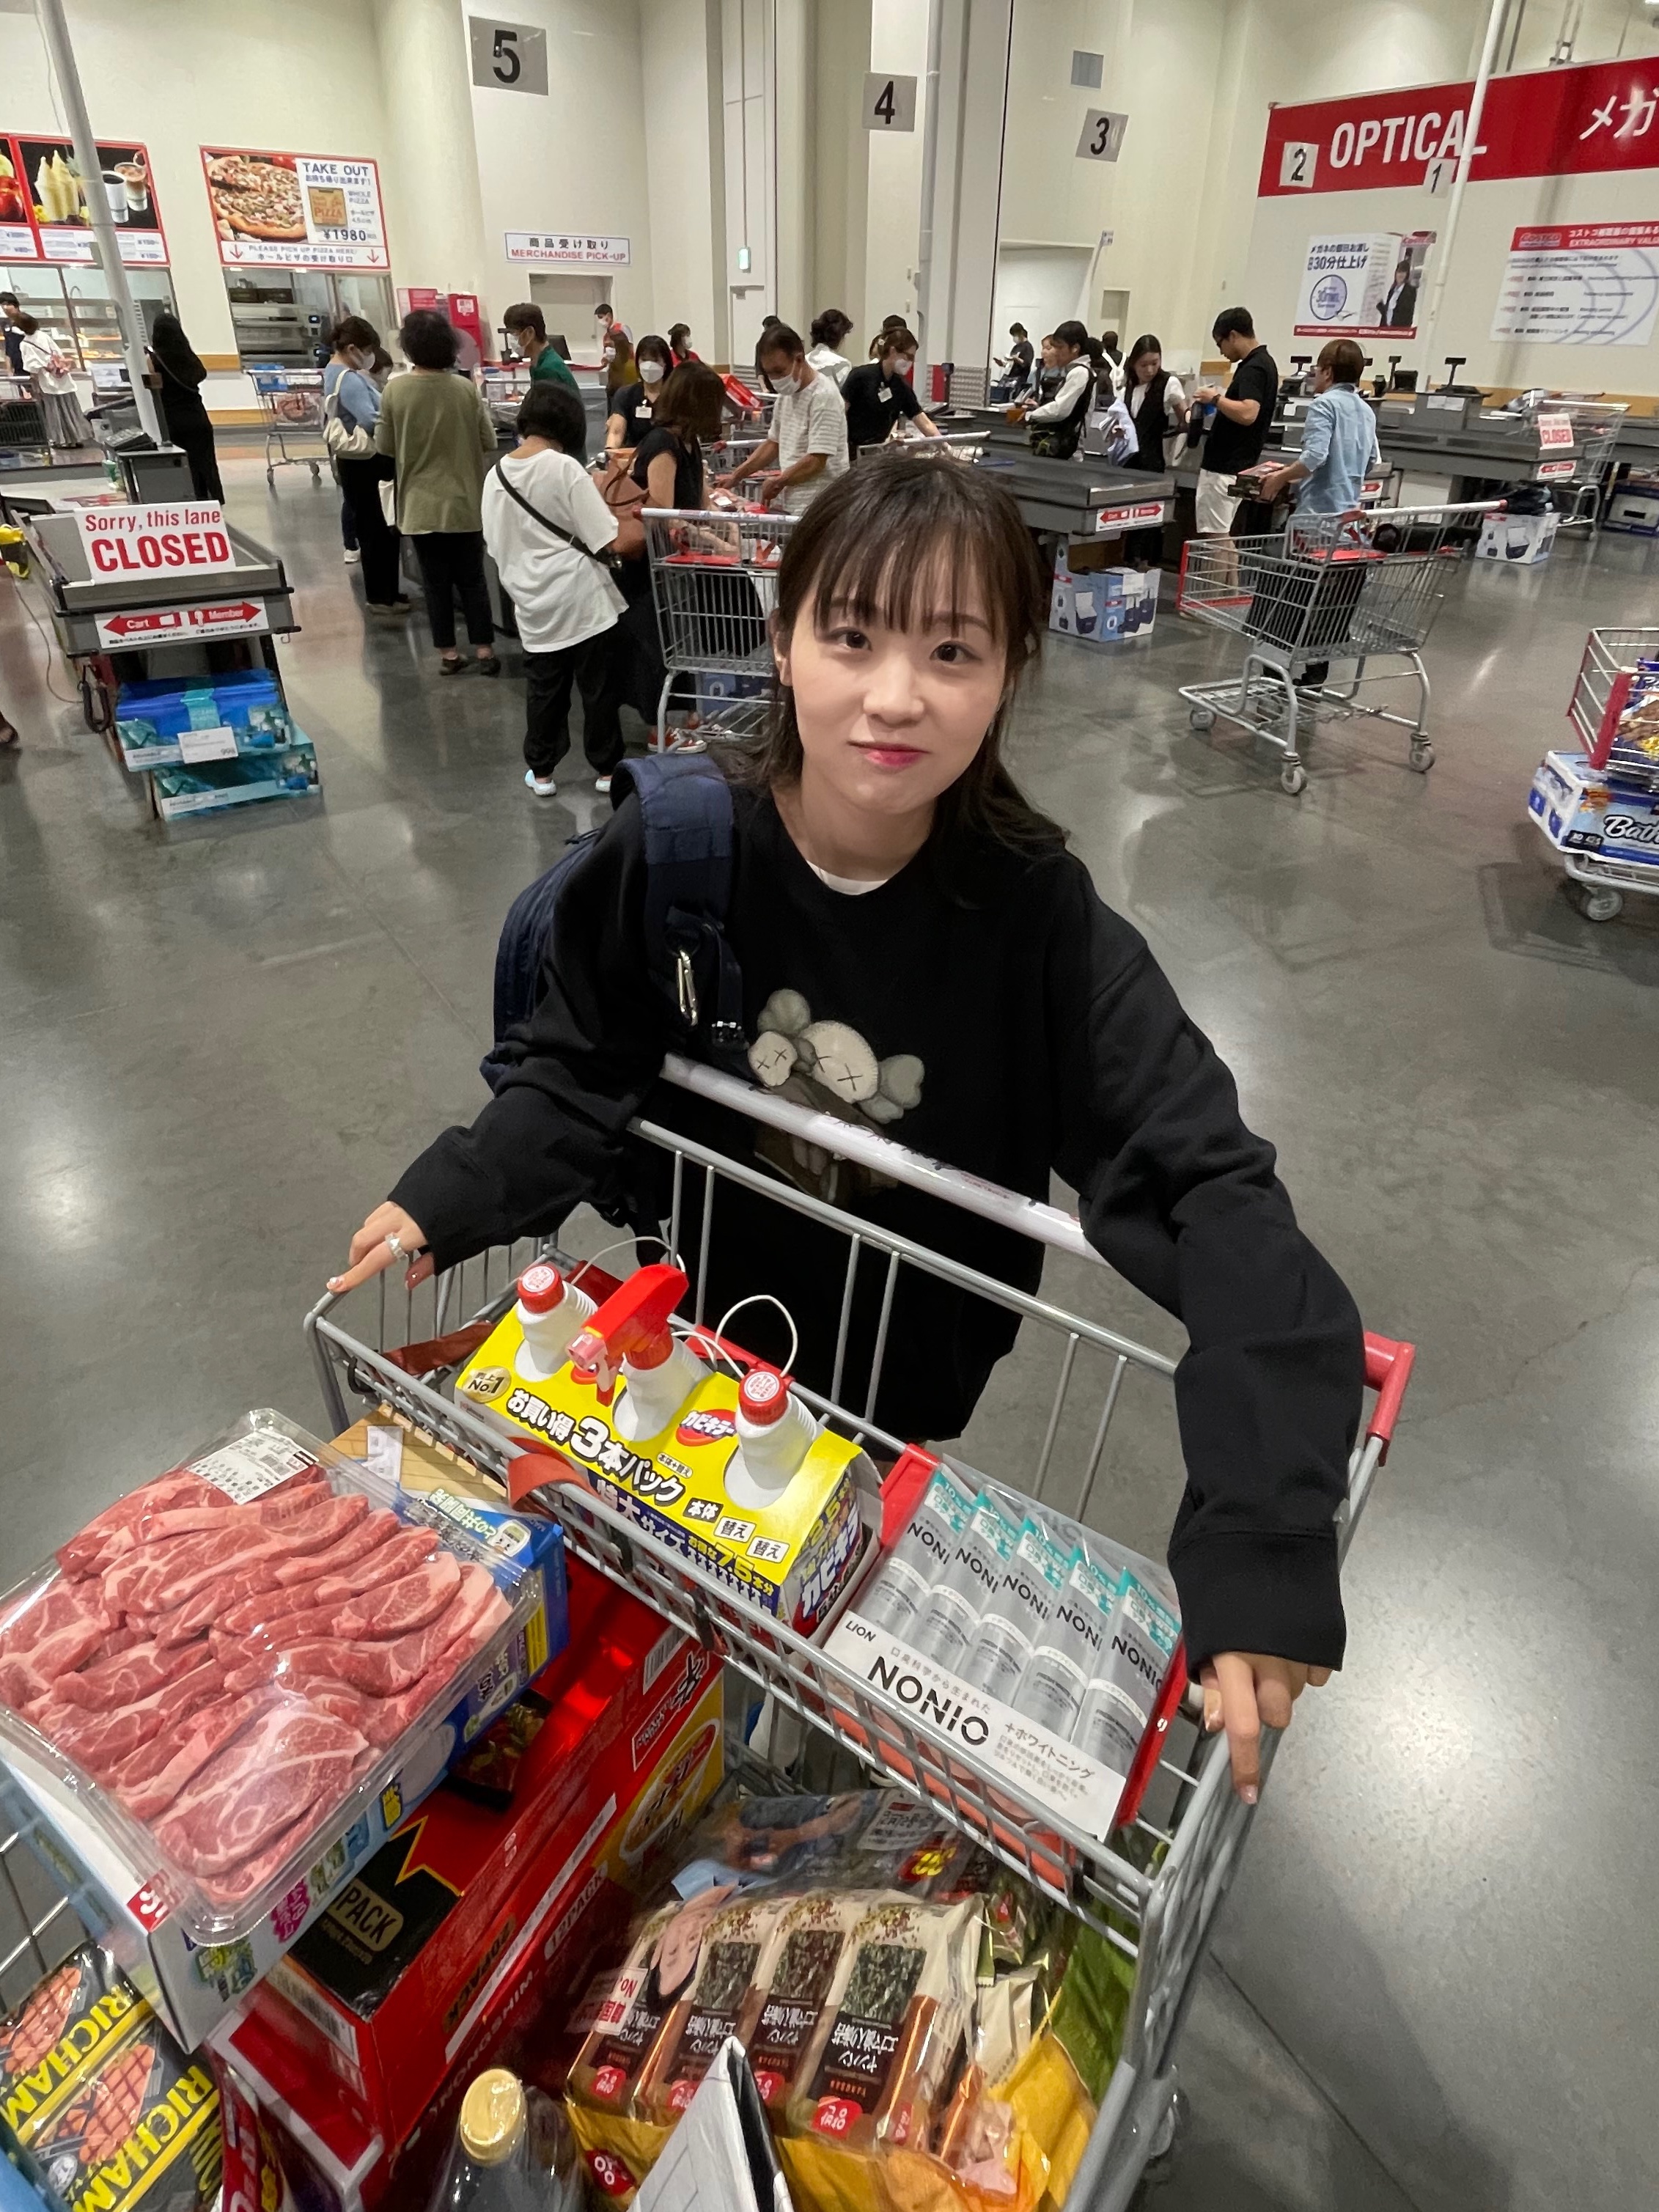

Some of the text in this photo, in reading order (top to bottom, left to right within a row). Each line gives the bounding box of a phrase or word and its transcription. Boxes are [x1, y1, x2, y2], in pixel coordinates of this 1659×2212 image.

[492, 29, 520, 84] 5
[873, 81, 896, 125] 4
[1089, 117, 1111, 155] 3
[303, 162, 369, 177] TAKE OUT
[1290, 148, 1307, 182] 2
[1431, 163, 1443, 194] 1
[324, 229, 367, 241] ¥1980
[511, 249, 626, 261] MERCHANDISE PICK-UP
[86, 508, 221, 533] Sorry, this lane
[92, 532, 229, 573] CLOSED
[126, 609, 243, 629] Cart Member
[468, 1376, 504, 1394] No.1
[680, 1410, 736, 1437] カビキラー
[688, 1500, 781, 1559] 本体 替え 替え
[845, 1620, 877, 1642] LION
[867, 1656, 989, 1746] NONIO
[331, 1884, 397, 1944] PACK
[0, 1984, 137, 2128] RICHAM
[820, 2105, 848, 2131] 양반
[73, 2065, 214, 2212] RICHAM
